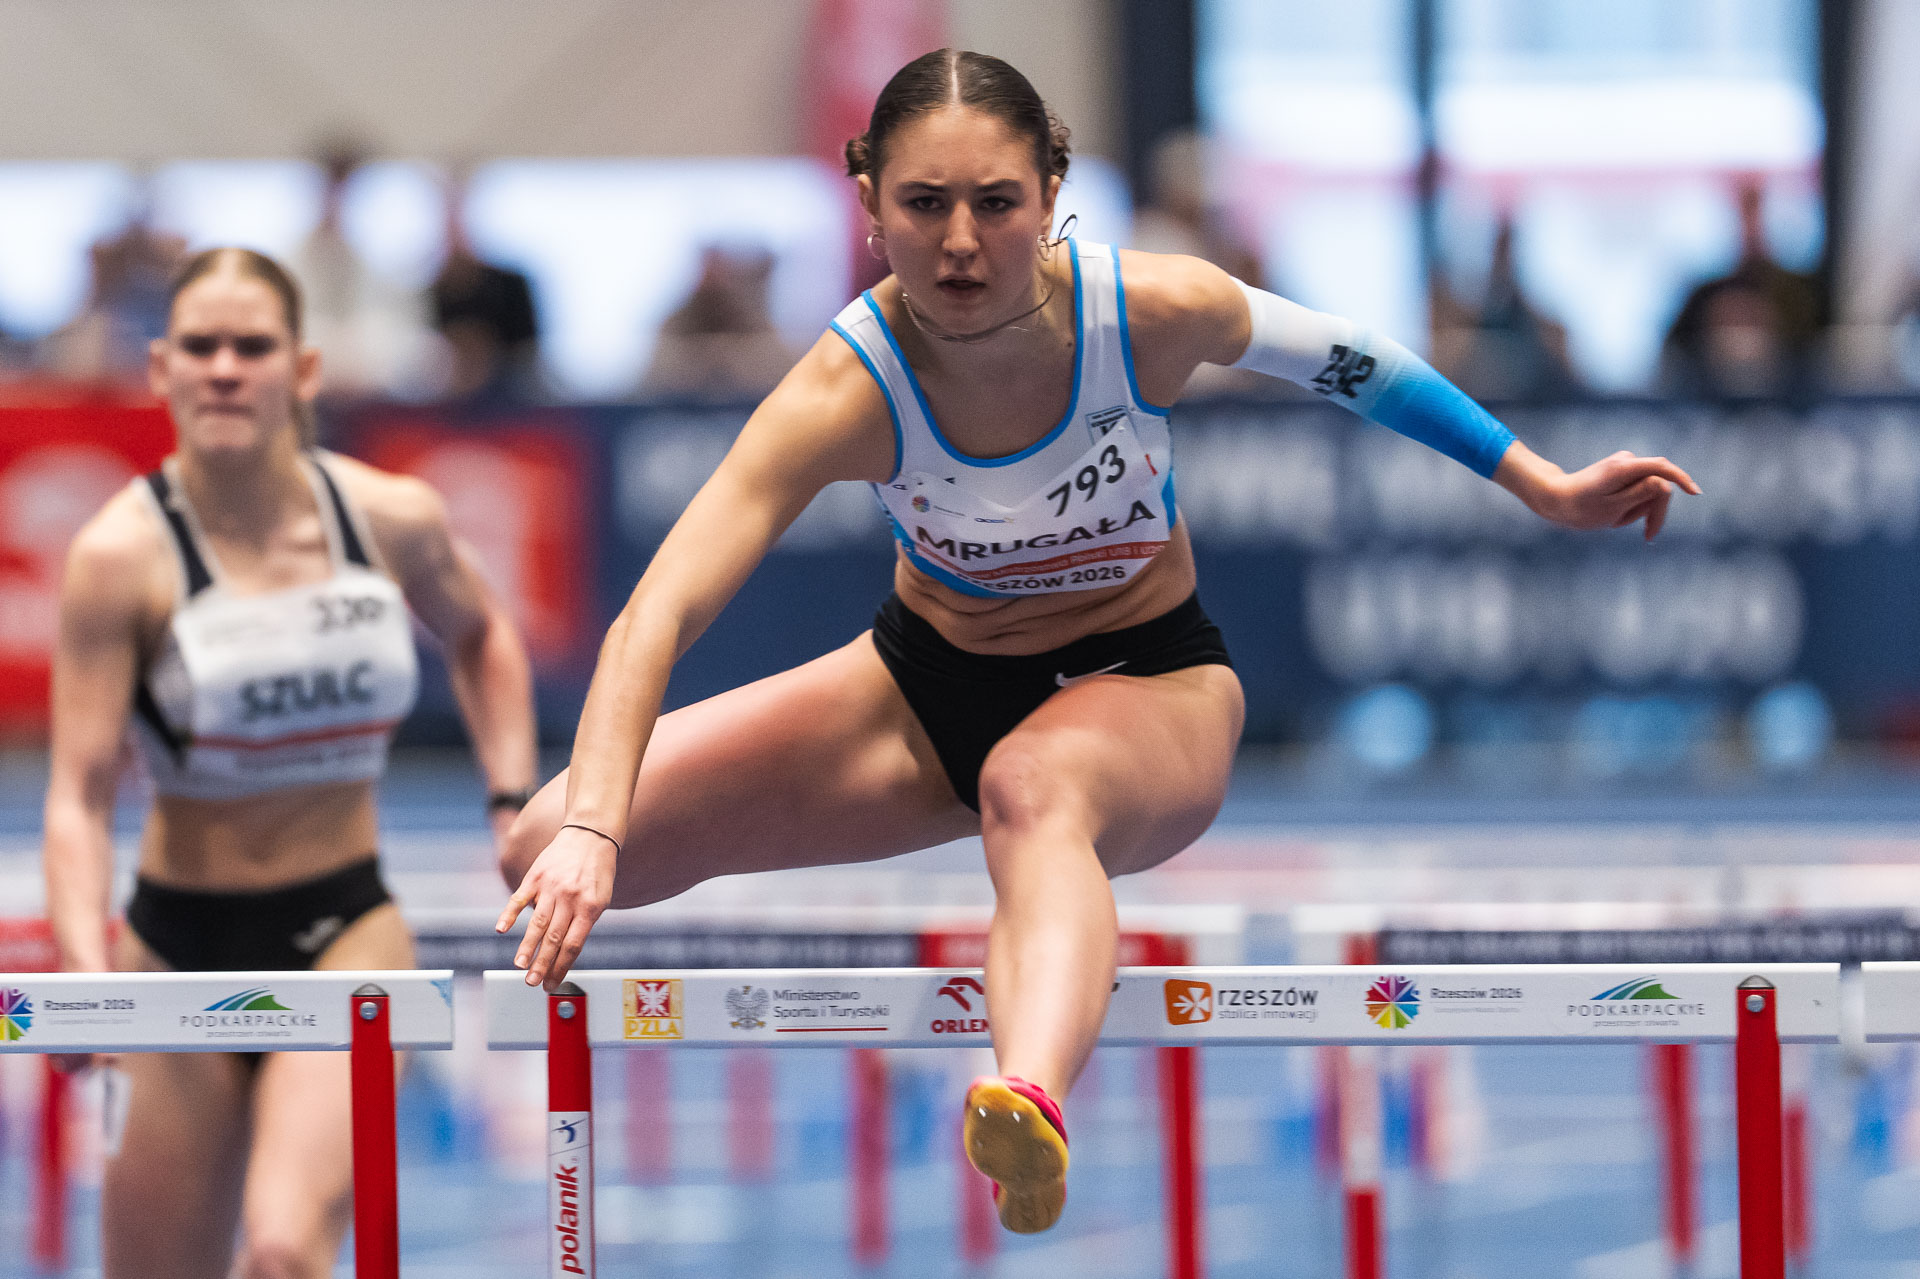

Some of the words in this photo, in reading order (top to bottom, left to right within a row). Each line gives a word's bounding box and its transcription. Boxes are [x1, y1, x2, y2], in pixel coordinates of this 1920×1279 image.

[1047, 444, 1126, 517] 793
[916, 500, 1156, 562] MRUGAŁA
[1071, 565, 1126, 585] 2026
[240, 659, 375, 721] SZULC
[773, 989, 861, 1001] Ministerstwo
[1218, 987, 1319, 1006] rzeszów
[1430, 987, 1487, 999] Rzeszów
[1490, 987, 1523, 999] 2026
[44, 999, 100, 1011] Rzeszów
[103, 999, 136, 1010] 2026
[773, 1006, 818, 1019] Sportu
[821, 1006, 827, 1017] i
[828, 1005, 890, 1019] Turystyki
[1566, 1003, 1706, 1017] PODKARPACKIE
[179, 1014, 318, 1028] PODKARPACKIE
[1218, 1009, 1257, 1019] stolica
[1261, 1009, 1318, 1023] innowacji
[624, 1019, 679, 1036] PZLA
[554, 1164, 585, 1275] polanik
